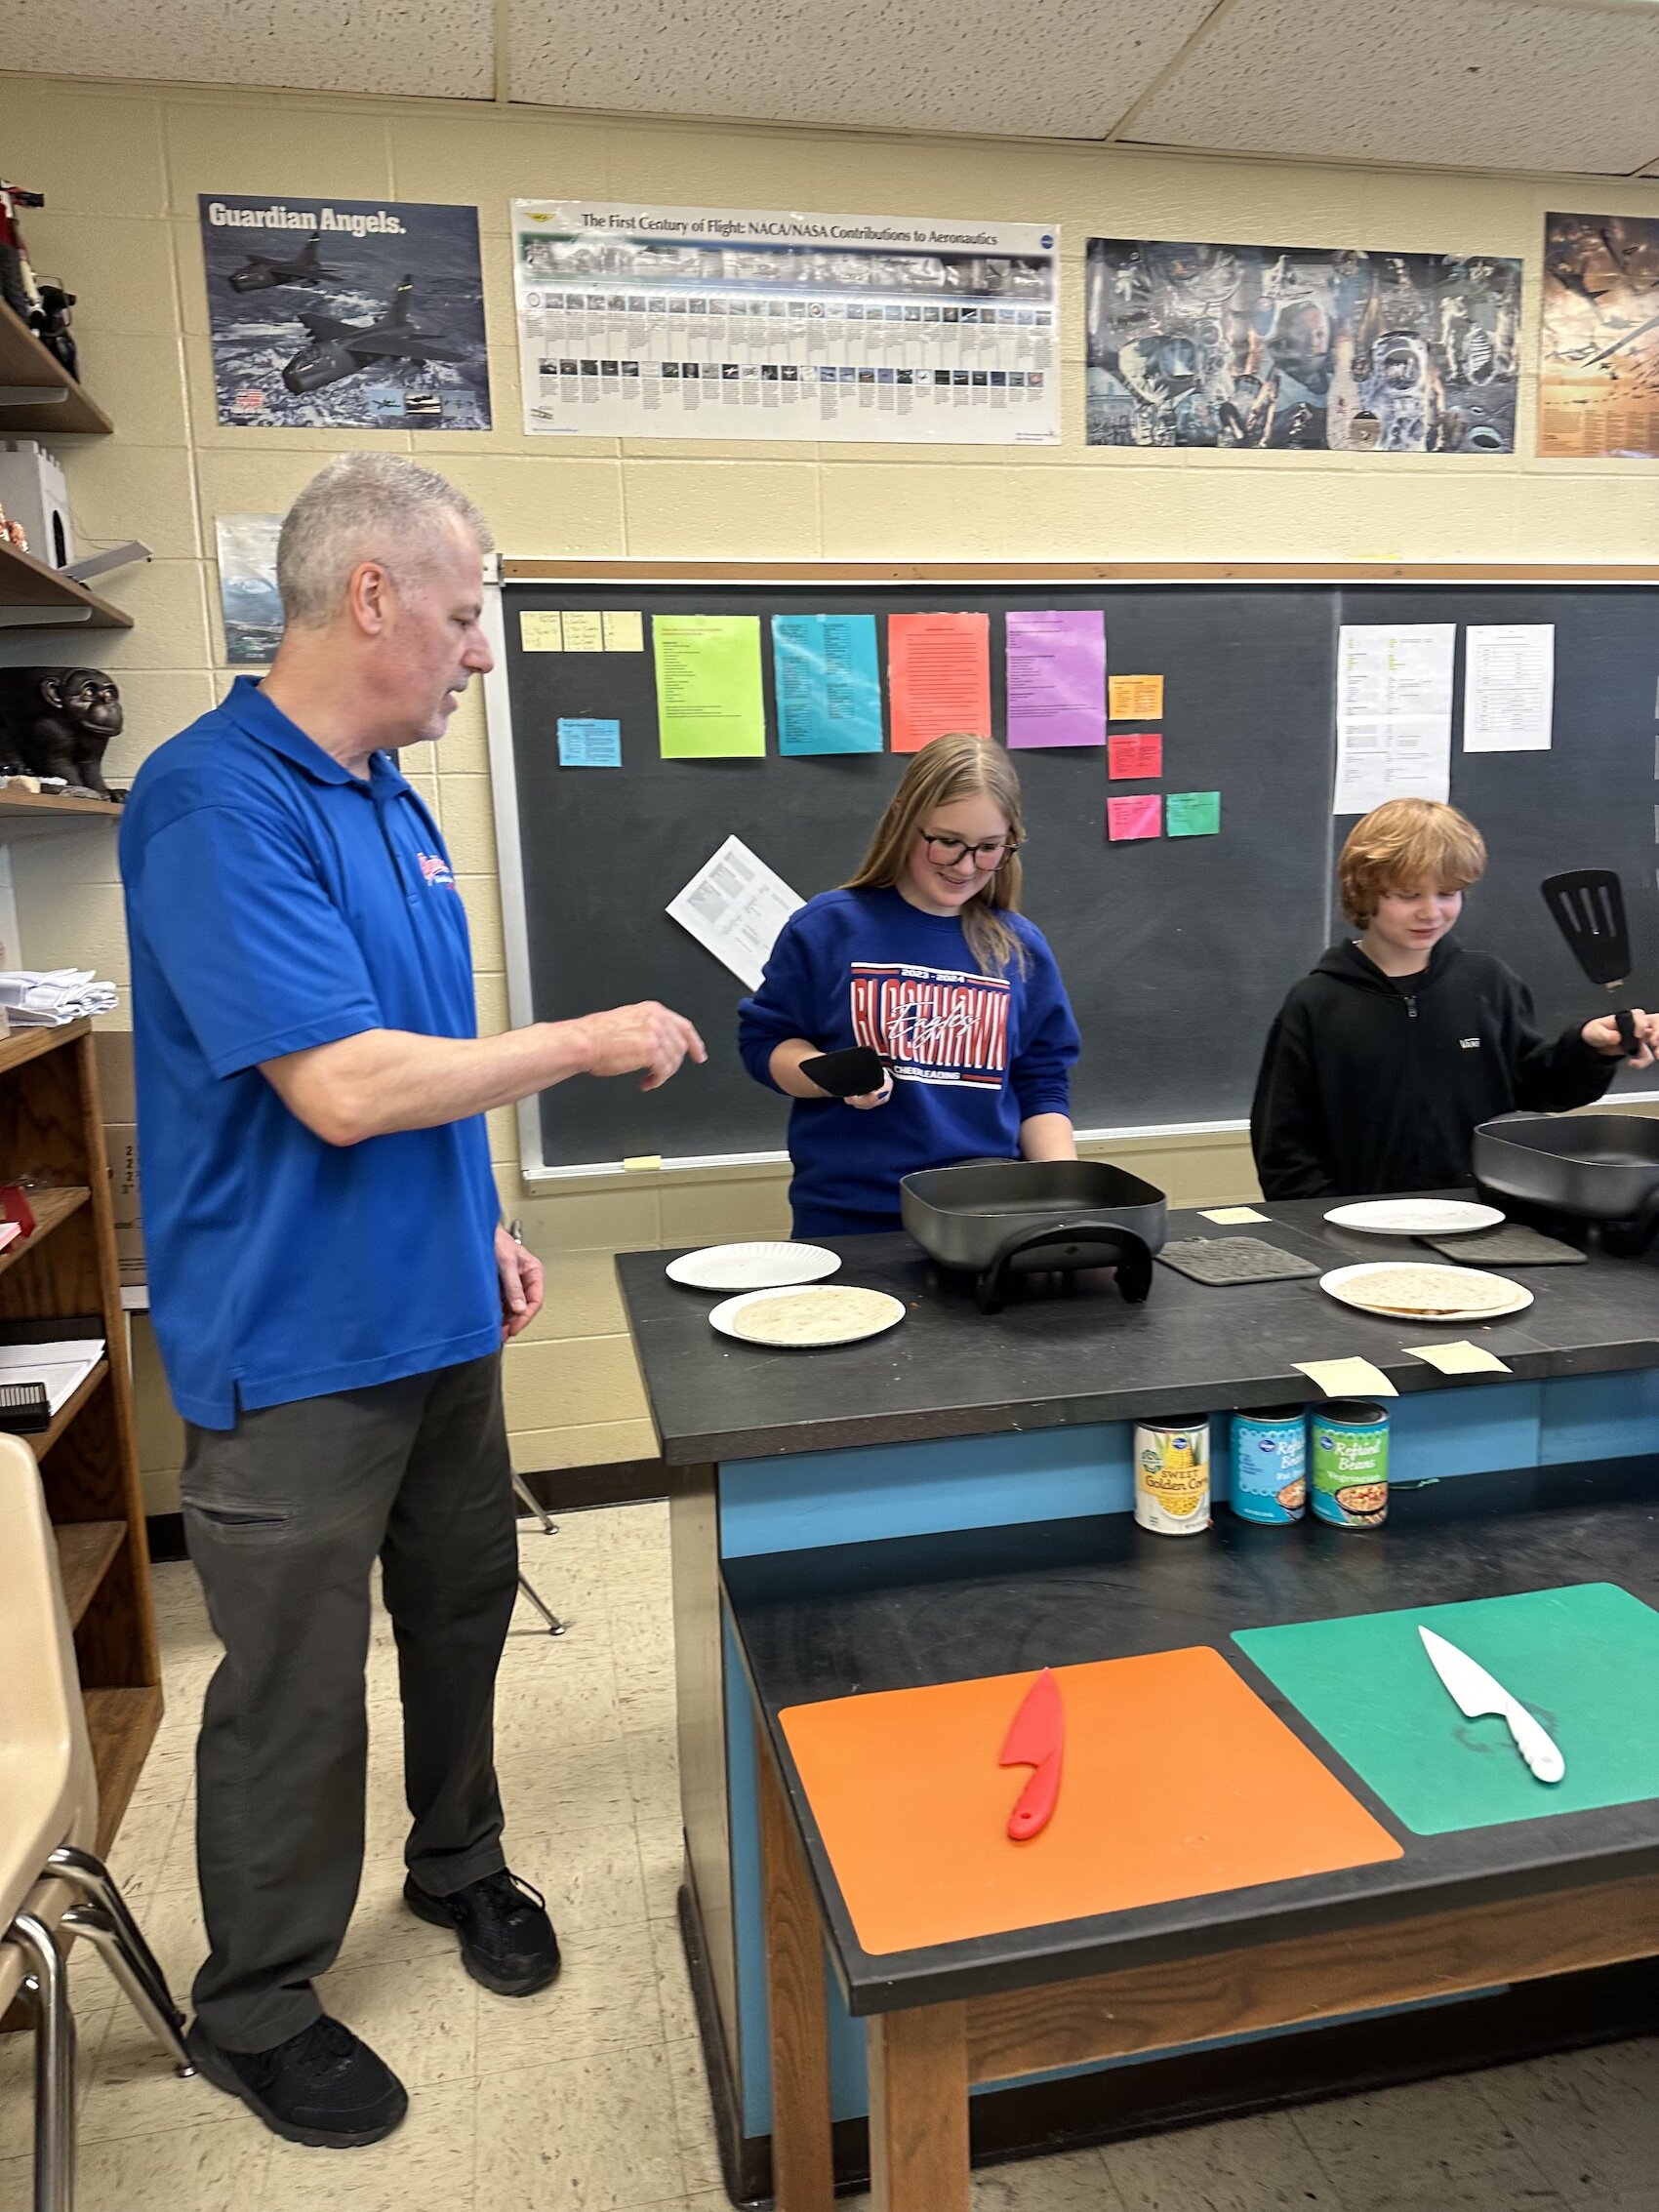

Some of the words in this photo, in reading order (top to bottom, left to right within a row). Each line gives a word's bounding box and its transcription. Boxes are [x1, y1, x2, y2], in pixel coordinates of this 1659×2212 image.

[208, 202, 317, 230] Guardian
[320, 207, 407, 237] Angels.
[582, 214, 606, 227] The
[609, 215, 636, 229] First
[639, 217, 688, 235] Century
[692, 219, 706, 232] of
[708, 219, 746, 237] Flight:
[749, 221, 829, 238] NACA/NASA
[830, 225, 911, 242] Contributions
[913, 230, 927, 242] to
[928, 230, 998, 245] Aeronautics
[901, 969, 930, 979] 2023
[936, 974, 966, 984] 2024
[850, 978, 1011, 1070] BLACKHAWK
[886, 999, 981, 1050] Eagles
[893, 1065, 961, 1080] CHEERLEADING
[1338, 1457, 1376, 1470] Beans
[1160, 1469, 1198, 1478] SWEET
[1145, 1475, 1188, 1491] Golden
